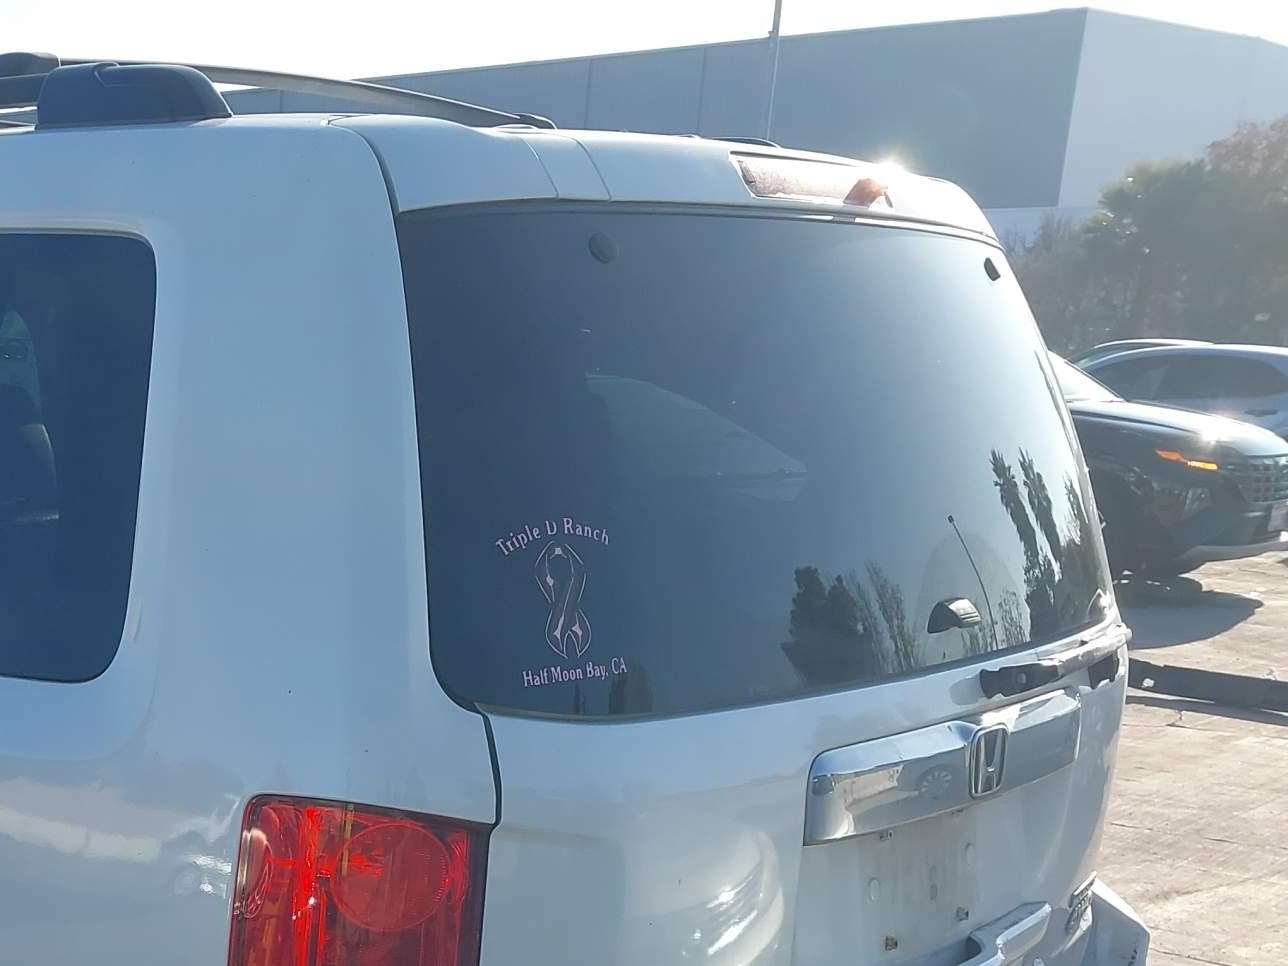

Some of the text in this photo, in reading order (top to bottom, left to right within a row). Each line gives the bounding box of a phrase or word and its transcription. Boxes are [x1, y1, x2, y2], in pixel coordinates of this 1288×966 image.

[496, 525, 542, 555] Triple
[563, 517, 610, 545] Ranch
[522, 657, 628, 687] Half Moon Bay, CA
